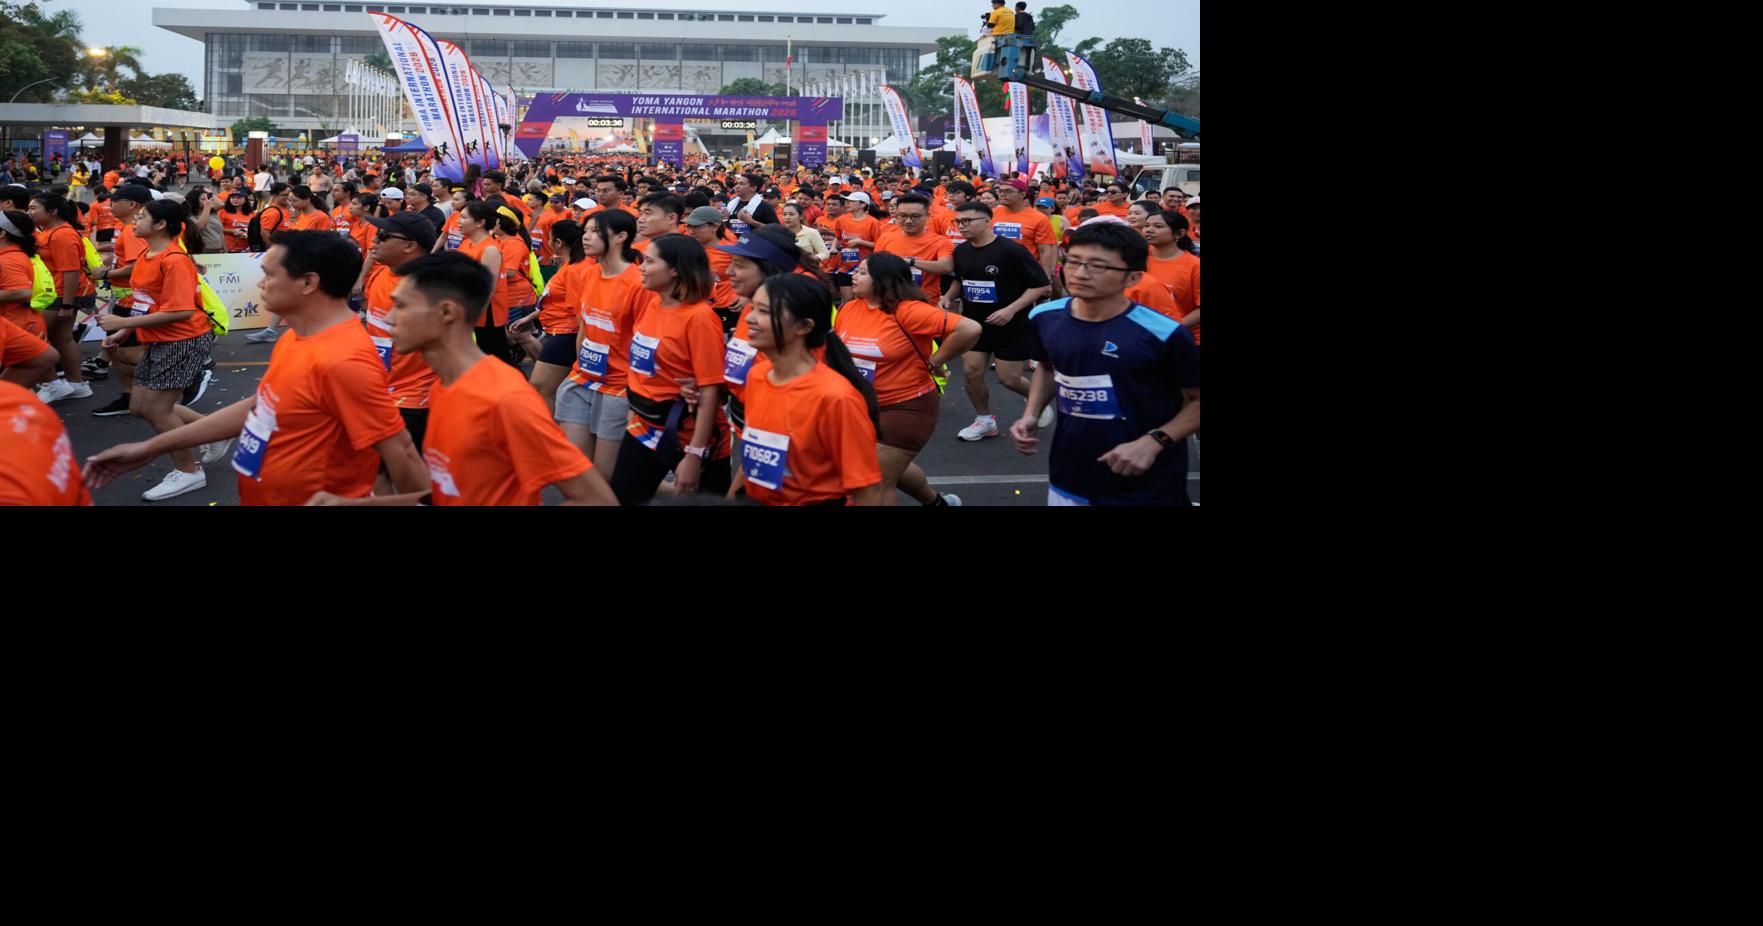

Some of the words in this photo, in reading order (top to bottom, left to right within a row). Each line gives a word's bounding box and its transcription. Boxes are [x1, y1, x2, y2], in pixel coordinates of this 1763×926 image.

[393, 41, 426, 108] INTERNATIONAL
[418, 75, 442, 121] MARATHON
[632, 96, 660, 106] YOMA
[663, 98, 704, 106] YANGON
[422, 108, 433, 131] YOMA
[631, 106, 710, 116] INTERNATIONAL
[713, 107, 769, 117] MARATHON
[461, 113, 469, 132] YOMA
[588, 119, 623, 128] 00:03:36
[220, 276, 240, 284] FMI
[743, 444, 780, 467] F10682
